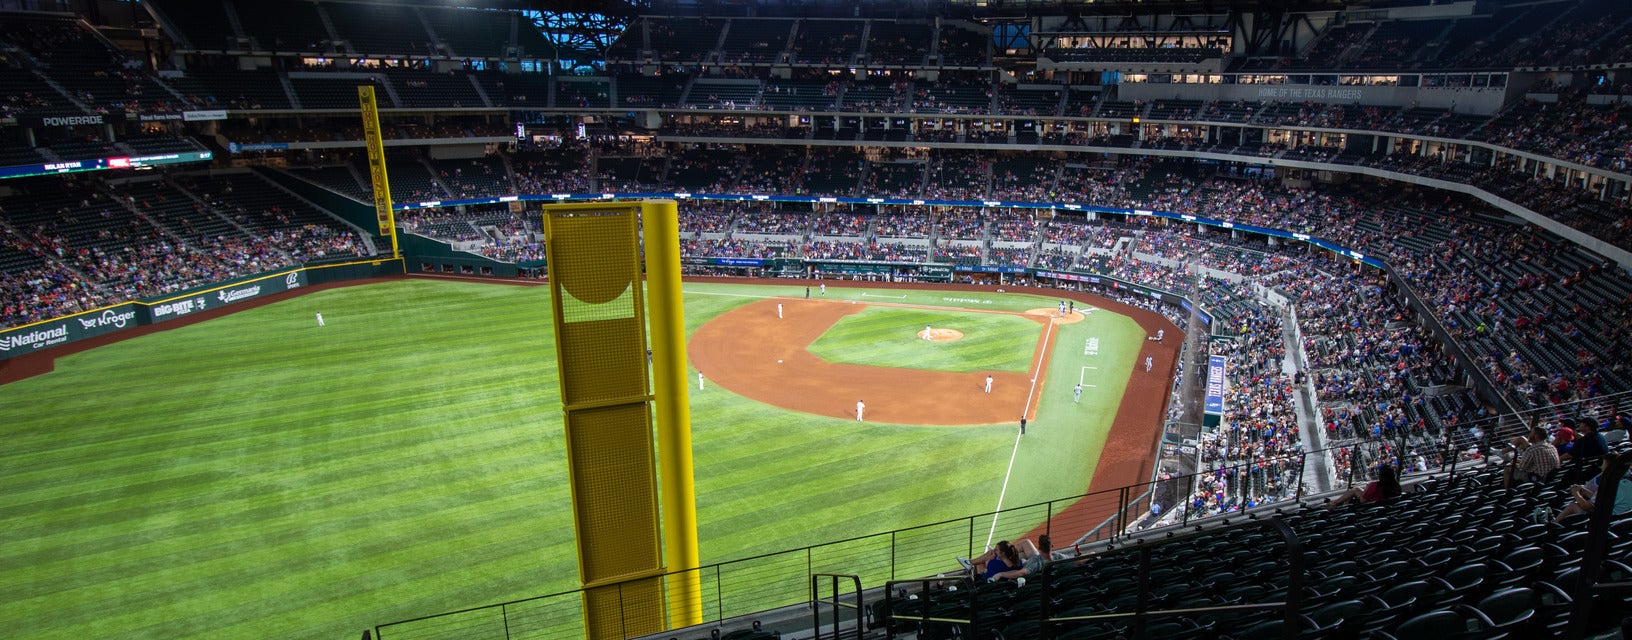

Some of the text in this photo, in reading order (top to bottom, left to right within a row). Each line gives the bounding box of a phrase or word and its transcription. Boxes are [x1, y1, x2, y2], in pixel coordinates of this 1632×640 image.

[1258, 88, 1362, 99] HOME OF THE TEXAS RANGERS
[43, 115, 104, 127] POWERADE
[172, 299, 194, 312] BITE
[98, 310, 136, 328] Kroger
[11, 324, 67, 348] National
[33, 336, 67, 349] Car Rental
[1209, 365, 1223, 383] RANGERS
[1208, 383, 1221, 397] TEXAS
